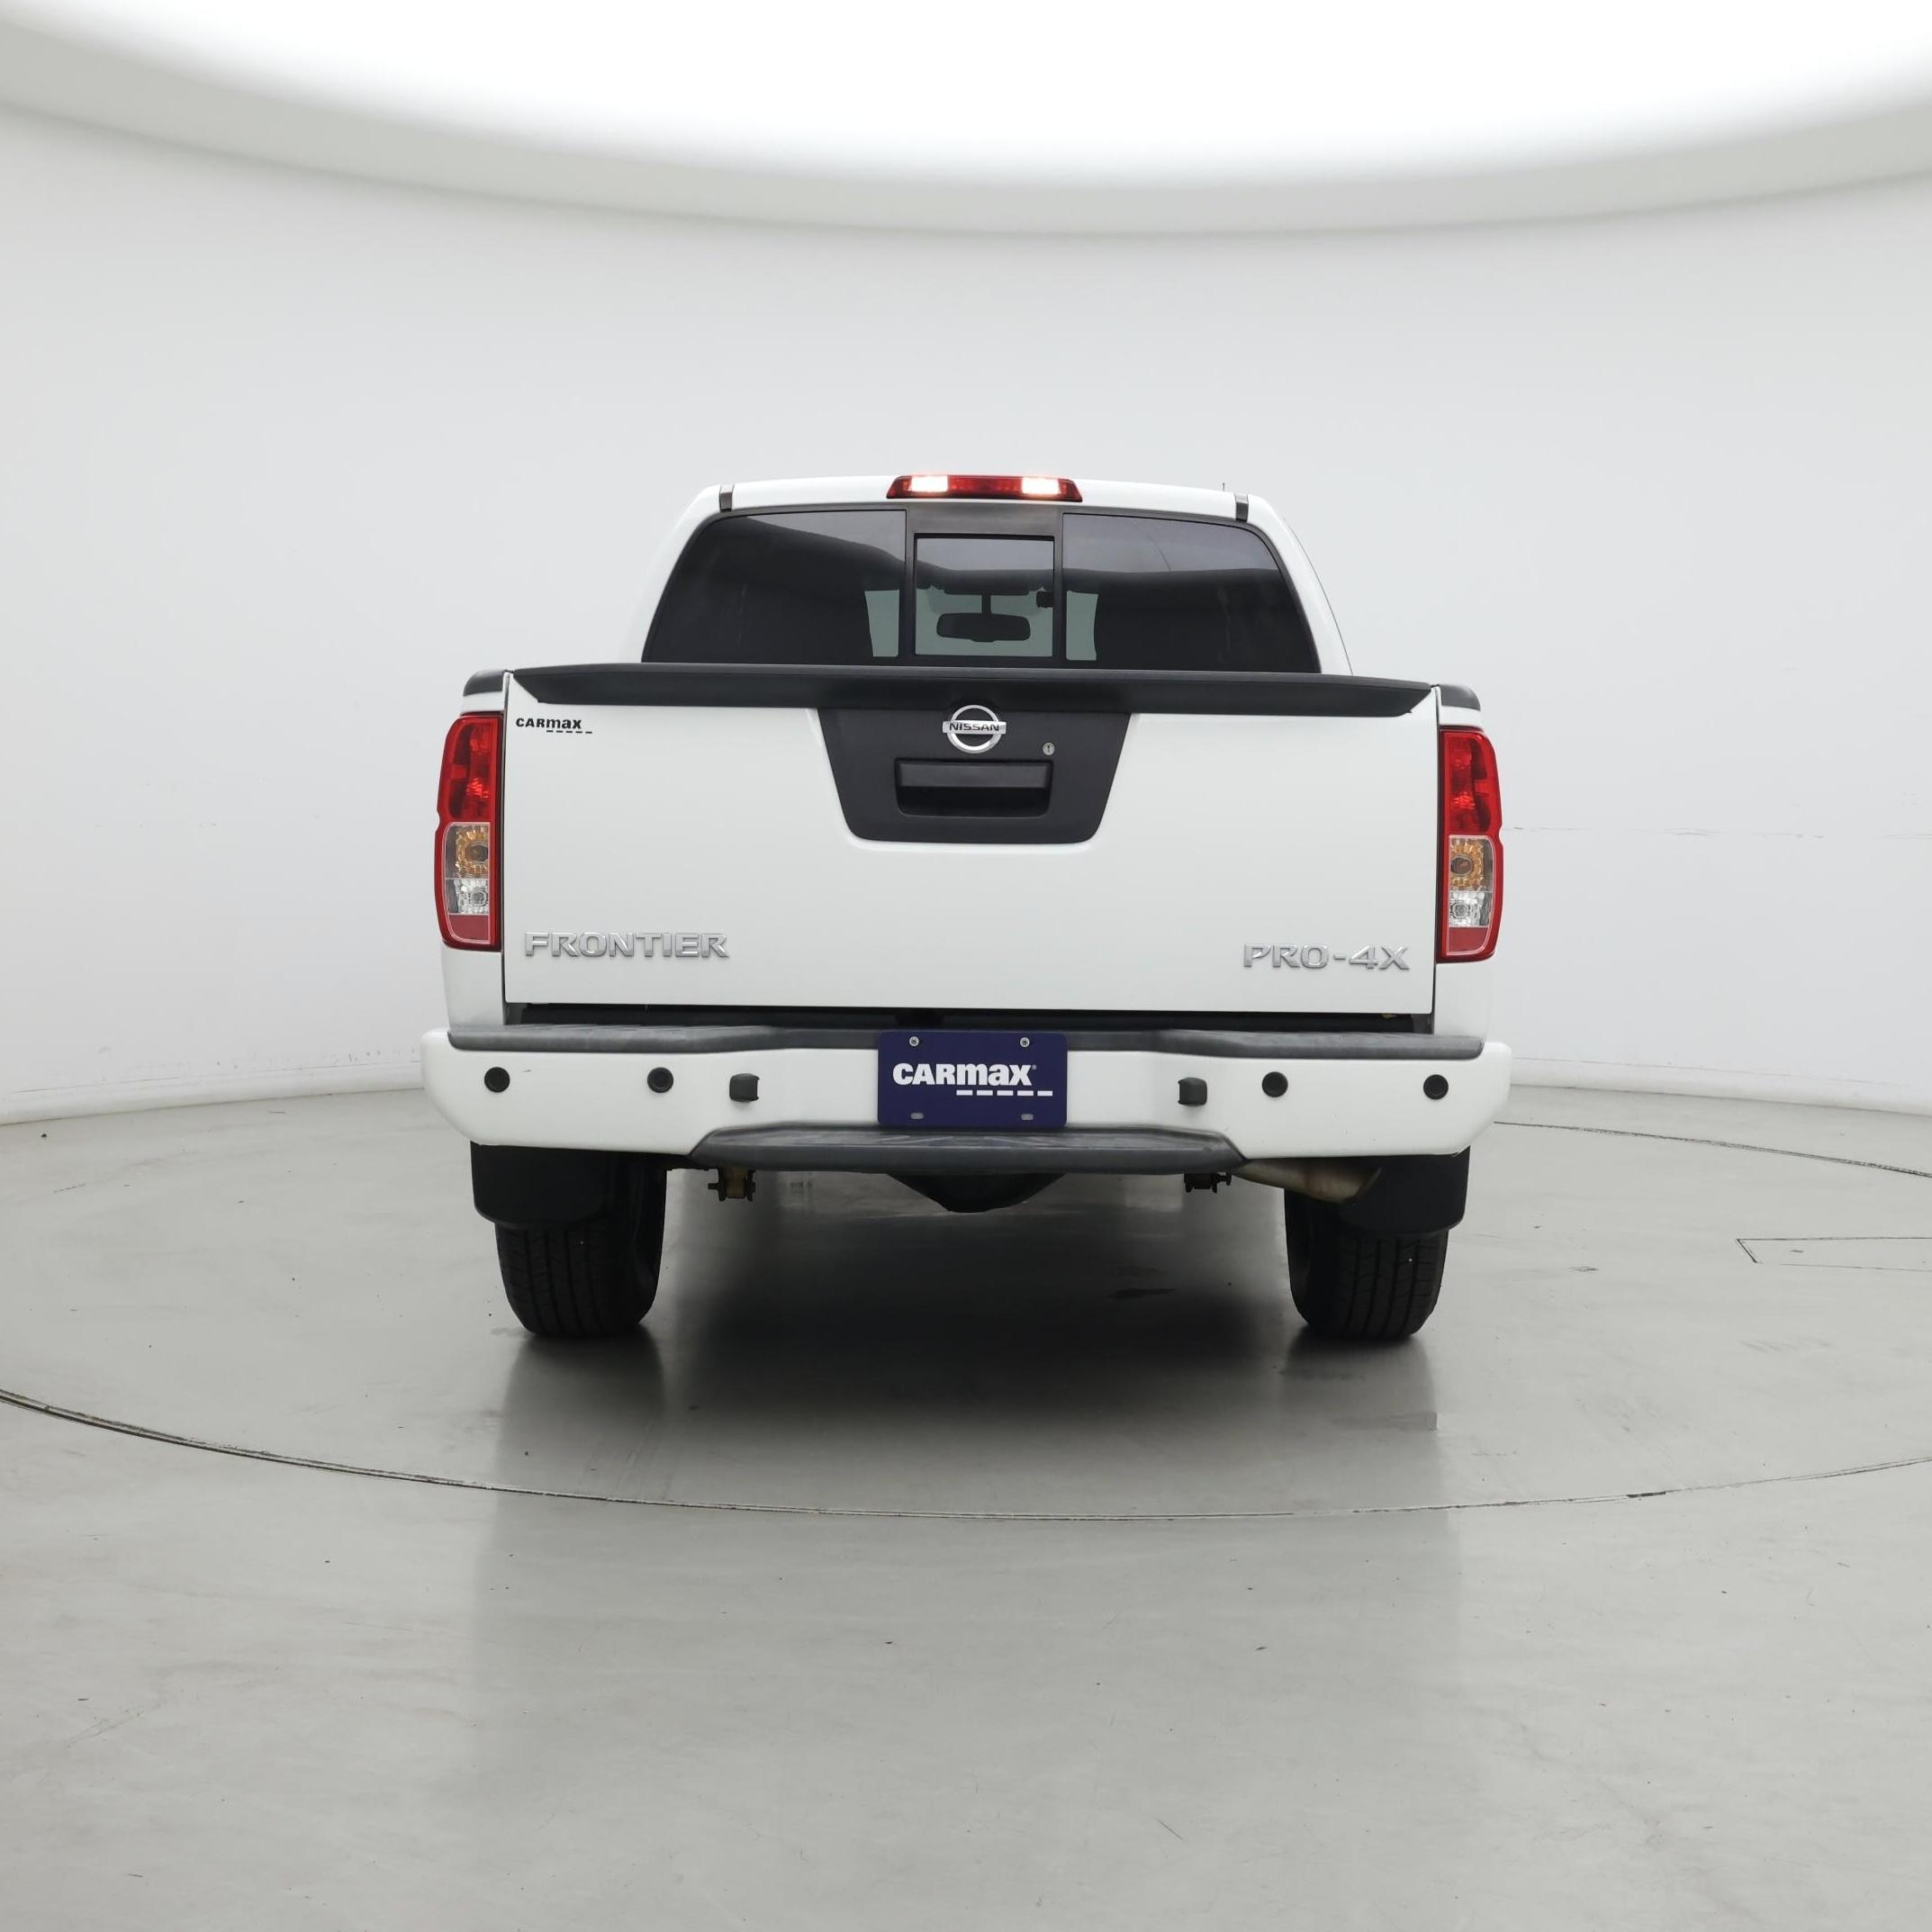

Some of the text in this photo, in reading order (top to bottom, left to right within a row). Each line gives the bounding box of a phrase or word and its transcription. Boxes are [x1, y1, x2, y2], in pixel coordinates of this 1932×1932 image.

[949, 722, 999, 732] NISSAN
[525, 931, 730, 958] FRONTIER
[1243, 943, 1410, 971] PRO-4X
